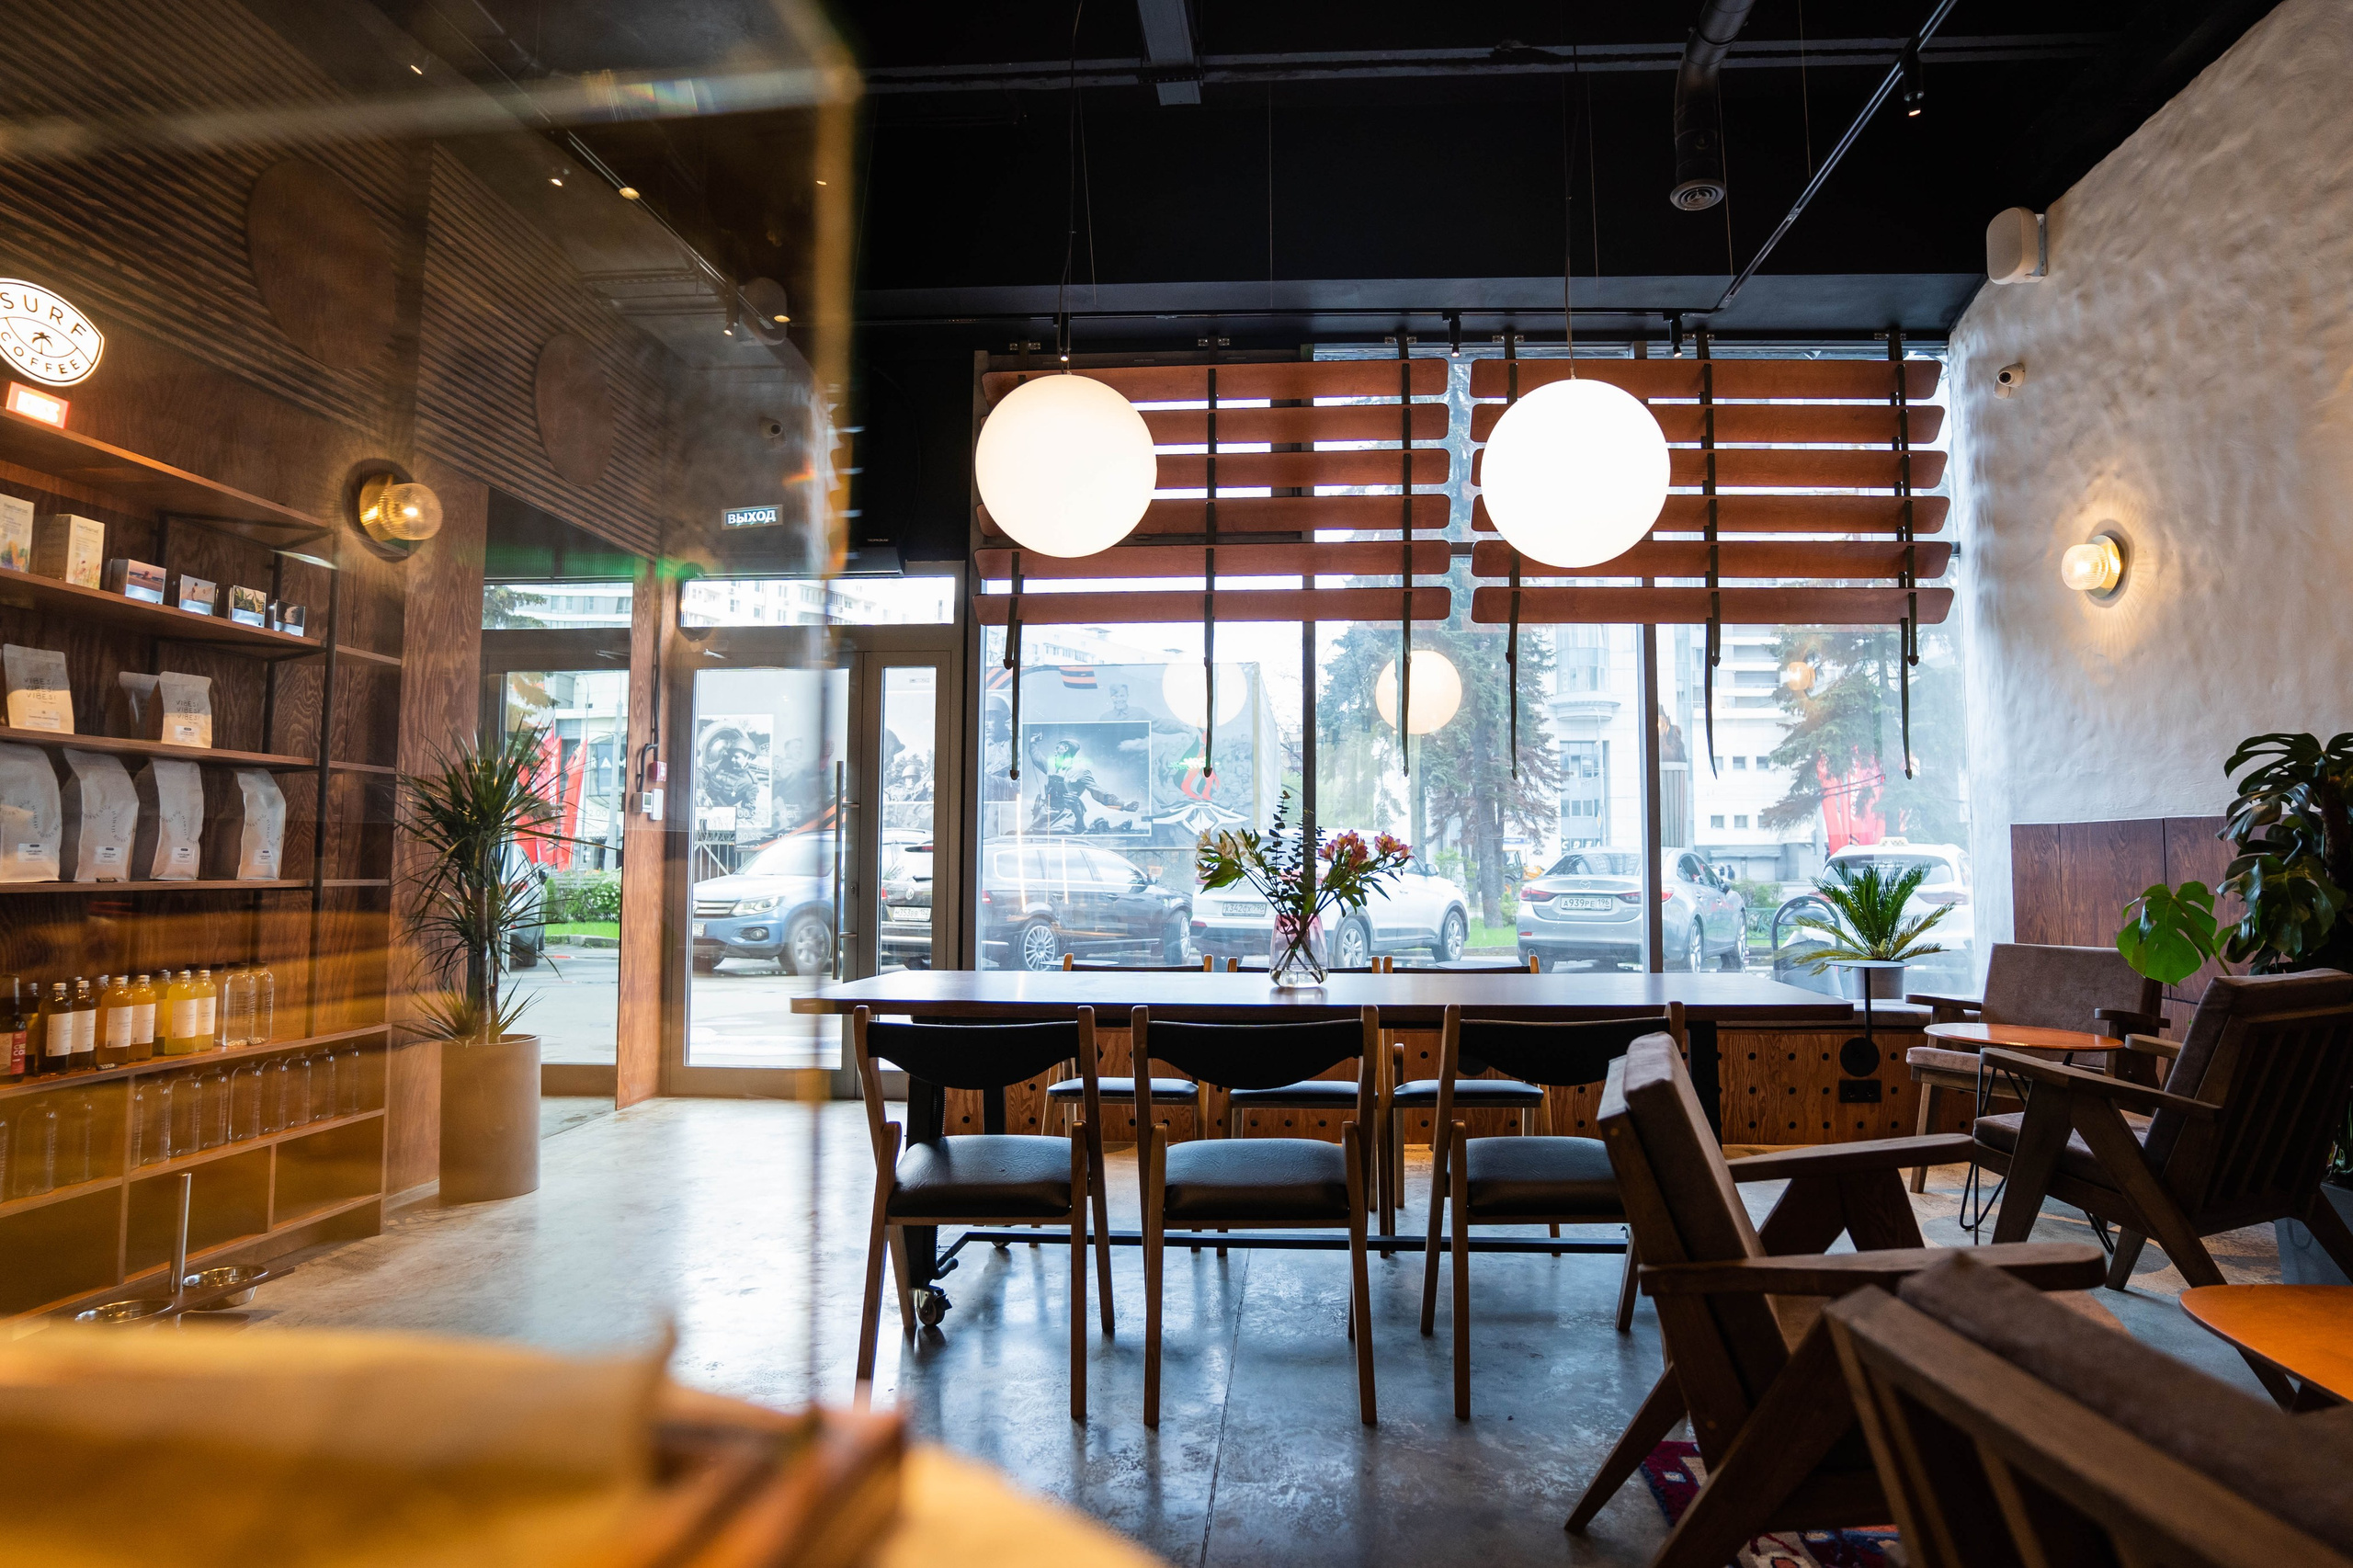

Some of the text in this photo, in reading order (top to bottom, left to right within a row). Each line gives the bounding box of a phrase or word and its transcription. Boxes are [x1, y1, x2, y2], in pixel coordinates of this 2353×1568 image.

[0, 292, 87, 336] SURF
[1, 332, 81, 374] COFFEE
[727, 509, 777, 525] ВЫХОД
